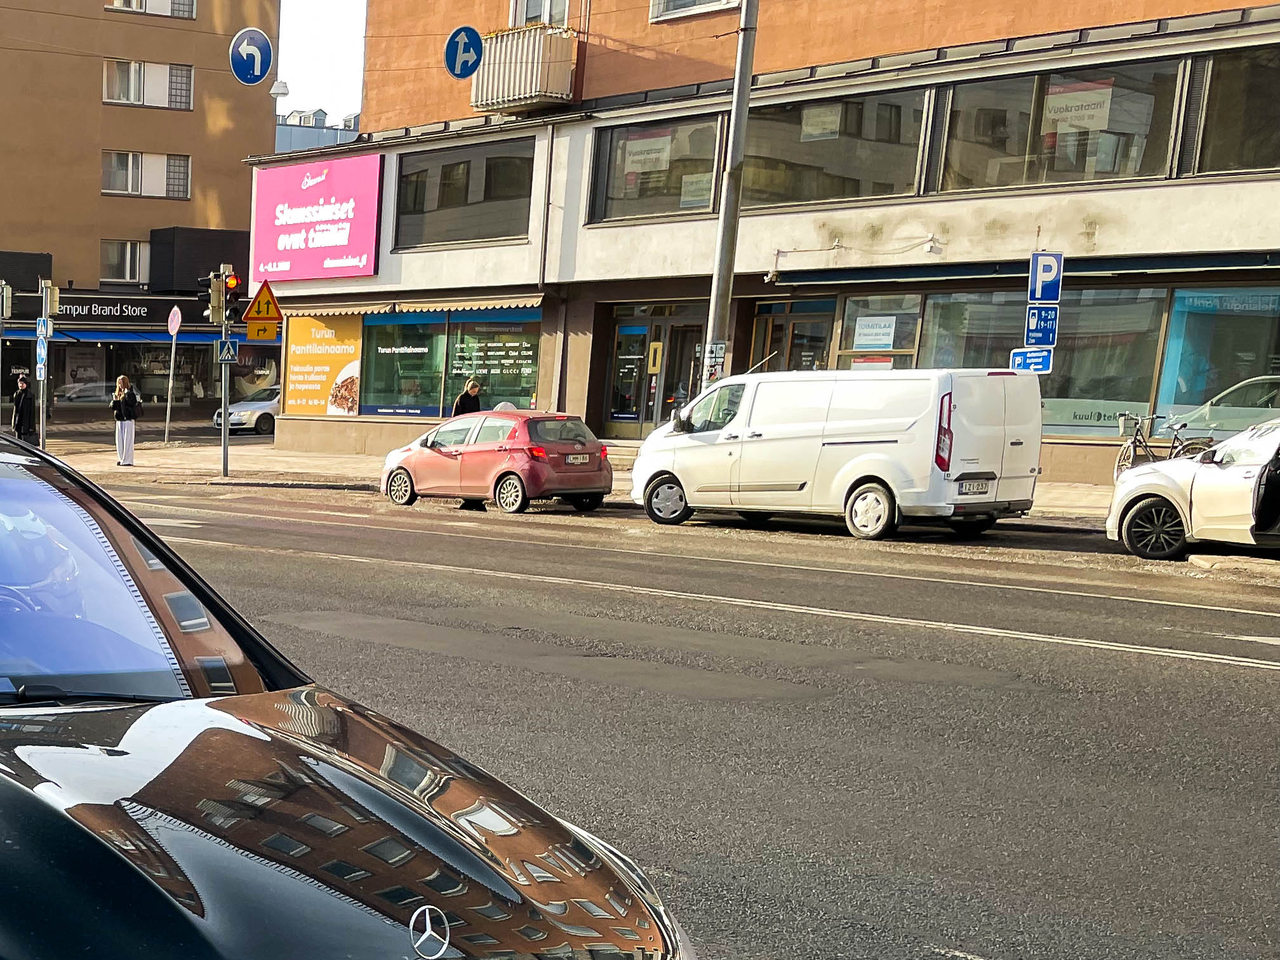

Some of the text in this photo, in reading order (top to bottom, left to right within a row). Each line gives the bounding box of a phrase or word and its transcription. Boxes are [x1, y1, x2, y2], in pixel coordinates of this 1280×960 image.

[1035, 256, 1058, 299] P
[58, 303, 148, 317] empur Brand Store
[311, 328, 336, 338] Turun
[291, 343, 355, 355] Panttilainaamo
